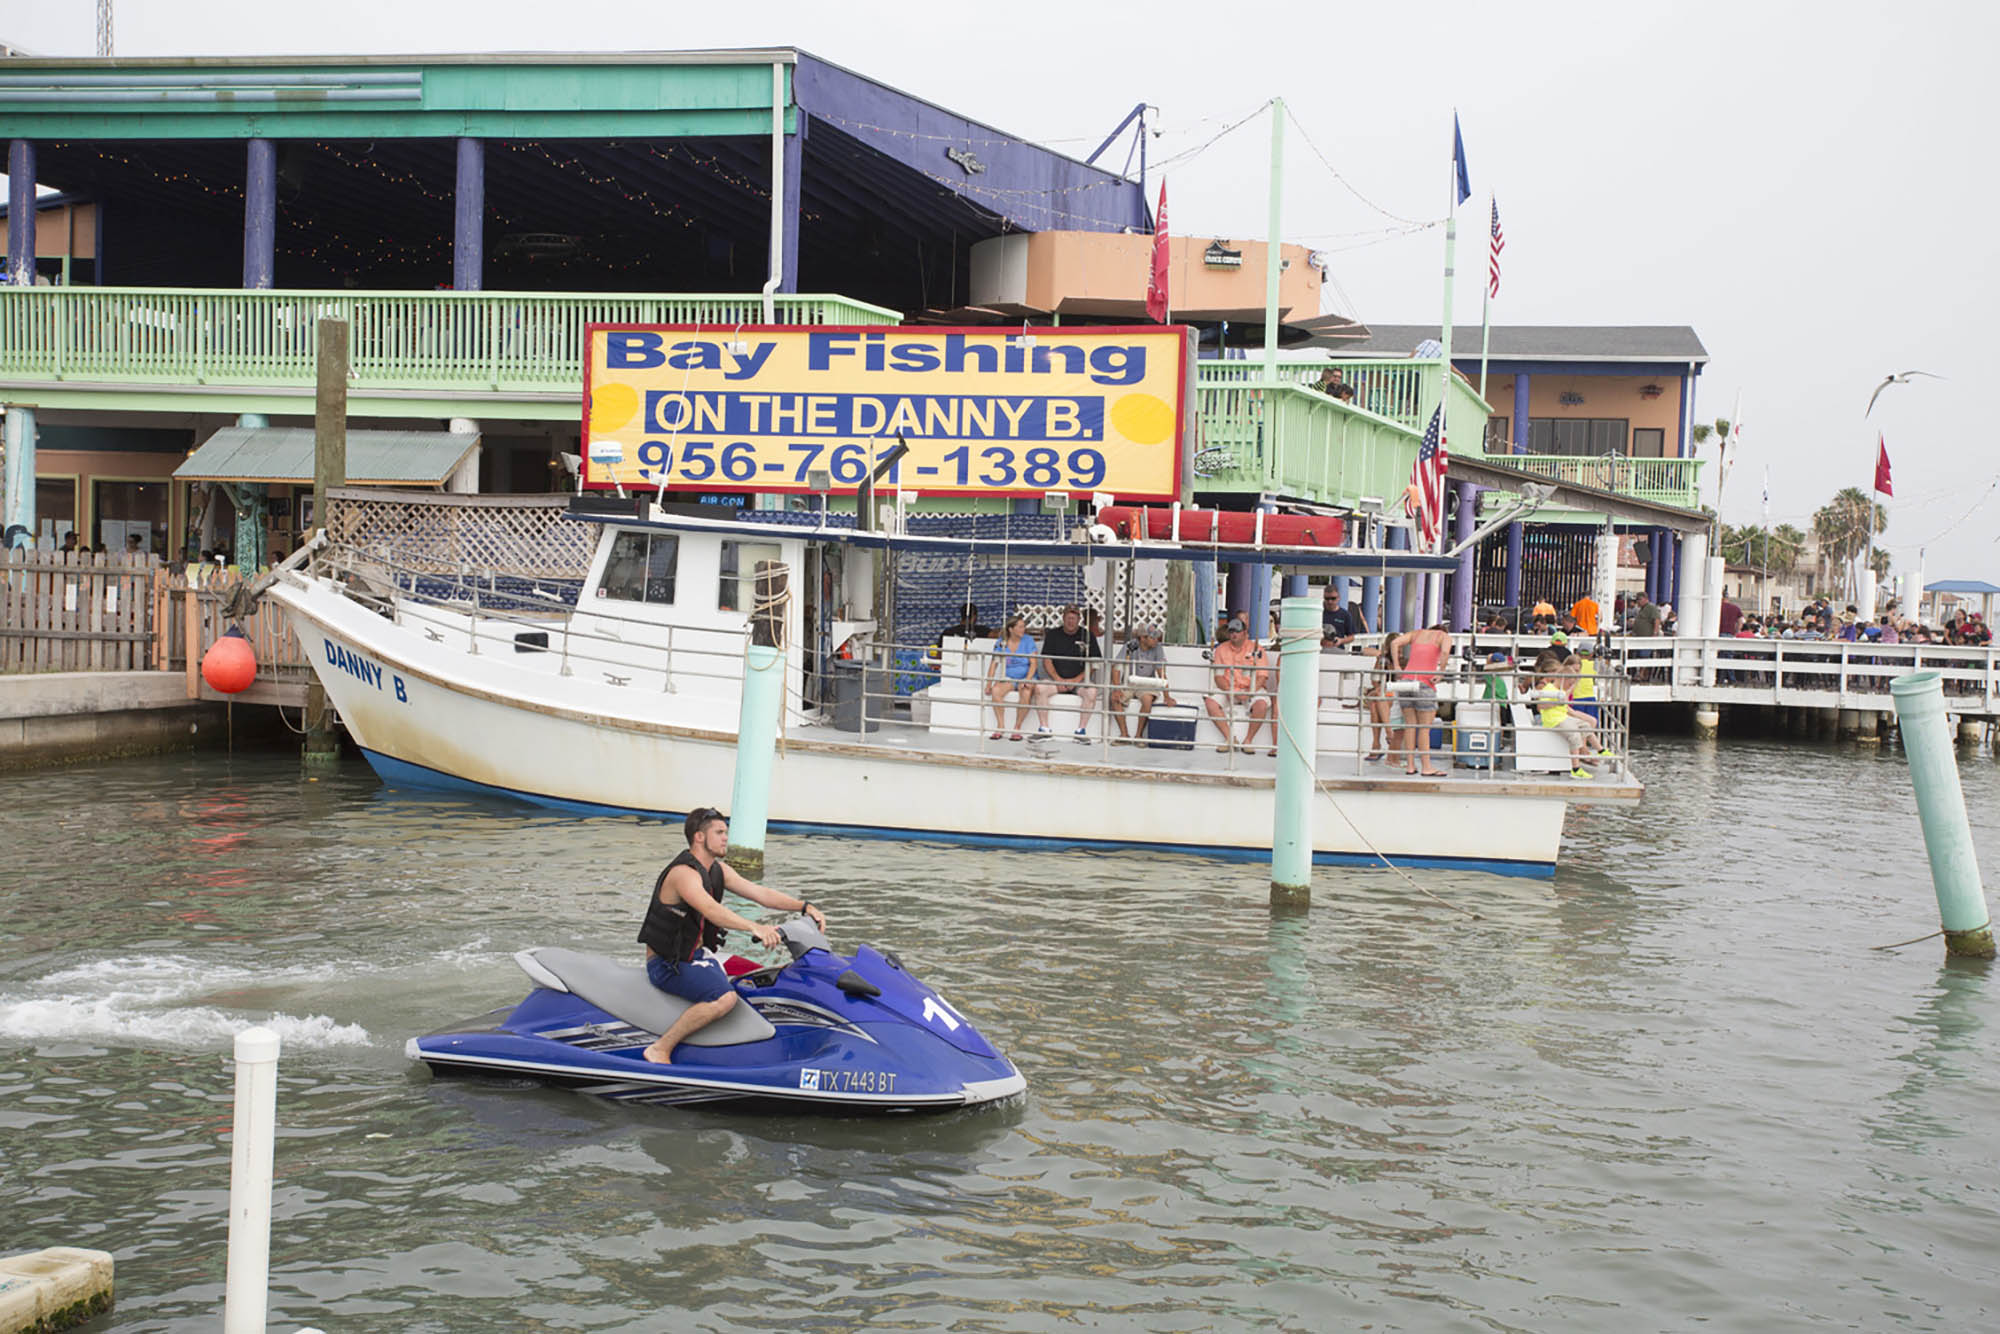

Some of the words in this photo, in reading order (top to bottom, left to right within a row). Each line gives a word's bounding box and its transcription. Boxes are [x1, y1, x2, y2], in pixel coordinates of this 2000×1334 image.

[607, 332, 778, 381] Bay
[808, 333, 1147, 386] Fishing
[654, 394, 727, 433] ON
[739, 395, 838, 434] THE
[851, 396, 1035, 438] DANNY
[1044, 399, 1093, 438] B.
[637, 440, 1107, 489] 956-761-1389
[323, 638, 383, 691] DANNY
[392, 675, 408, 704] B
[922, 996, 960, 1032] 1
[807, 1072, 814, 1084] 7
[821, 1071, 839, 1091] TX
[842, 1071, 876, 1093] 7443
[878, 1071, 897, 1093] BT
